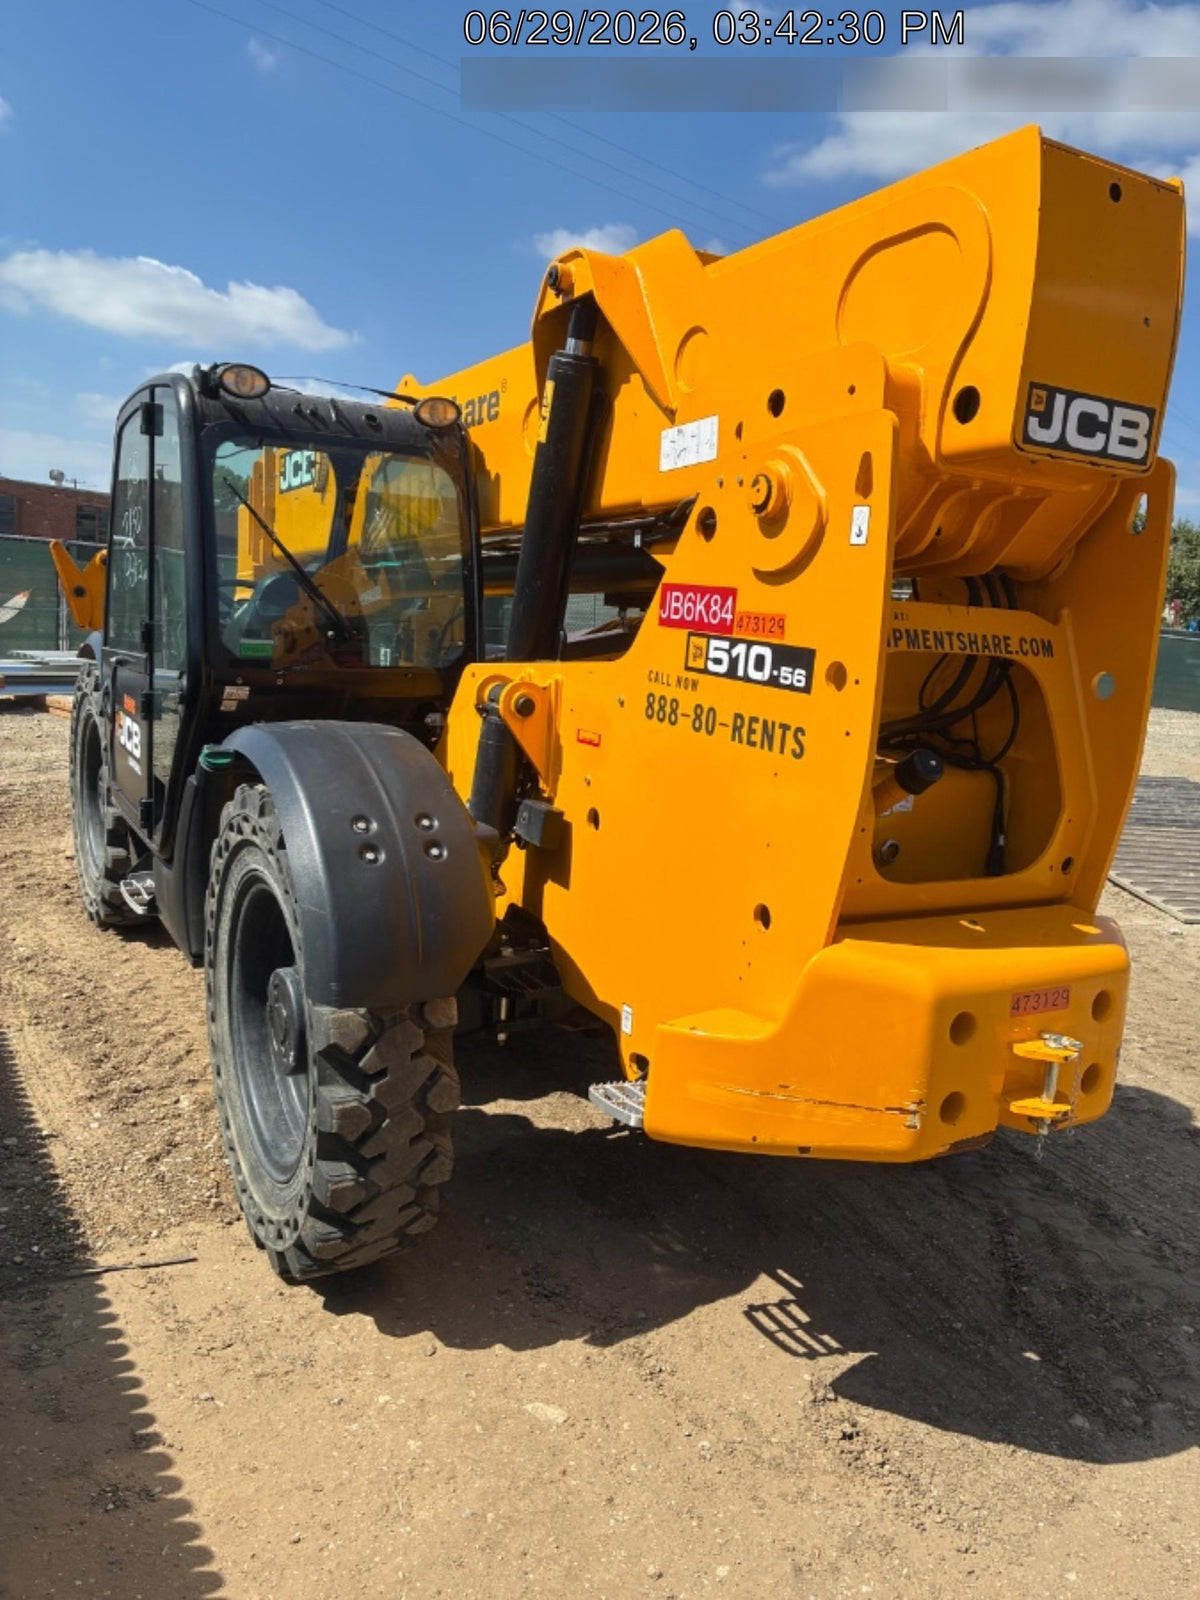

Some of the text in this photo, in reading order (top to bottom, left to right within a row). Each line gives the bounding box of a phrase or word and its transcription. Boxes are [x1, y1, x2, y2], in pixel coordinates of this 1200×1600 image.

[453, 389, 500, 428] are
[1027, 392, 1150, 460] JCB
[660, 591, 734, 626] JB6K84
[736, 614, 785, 635] 473129
[648, 670, 700, 692] CALL NOW
[644, 692, 807, 760] 888-80-RENTS
[1012, 989, 1070, 1013] 473129
